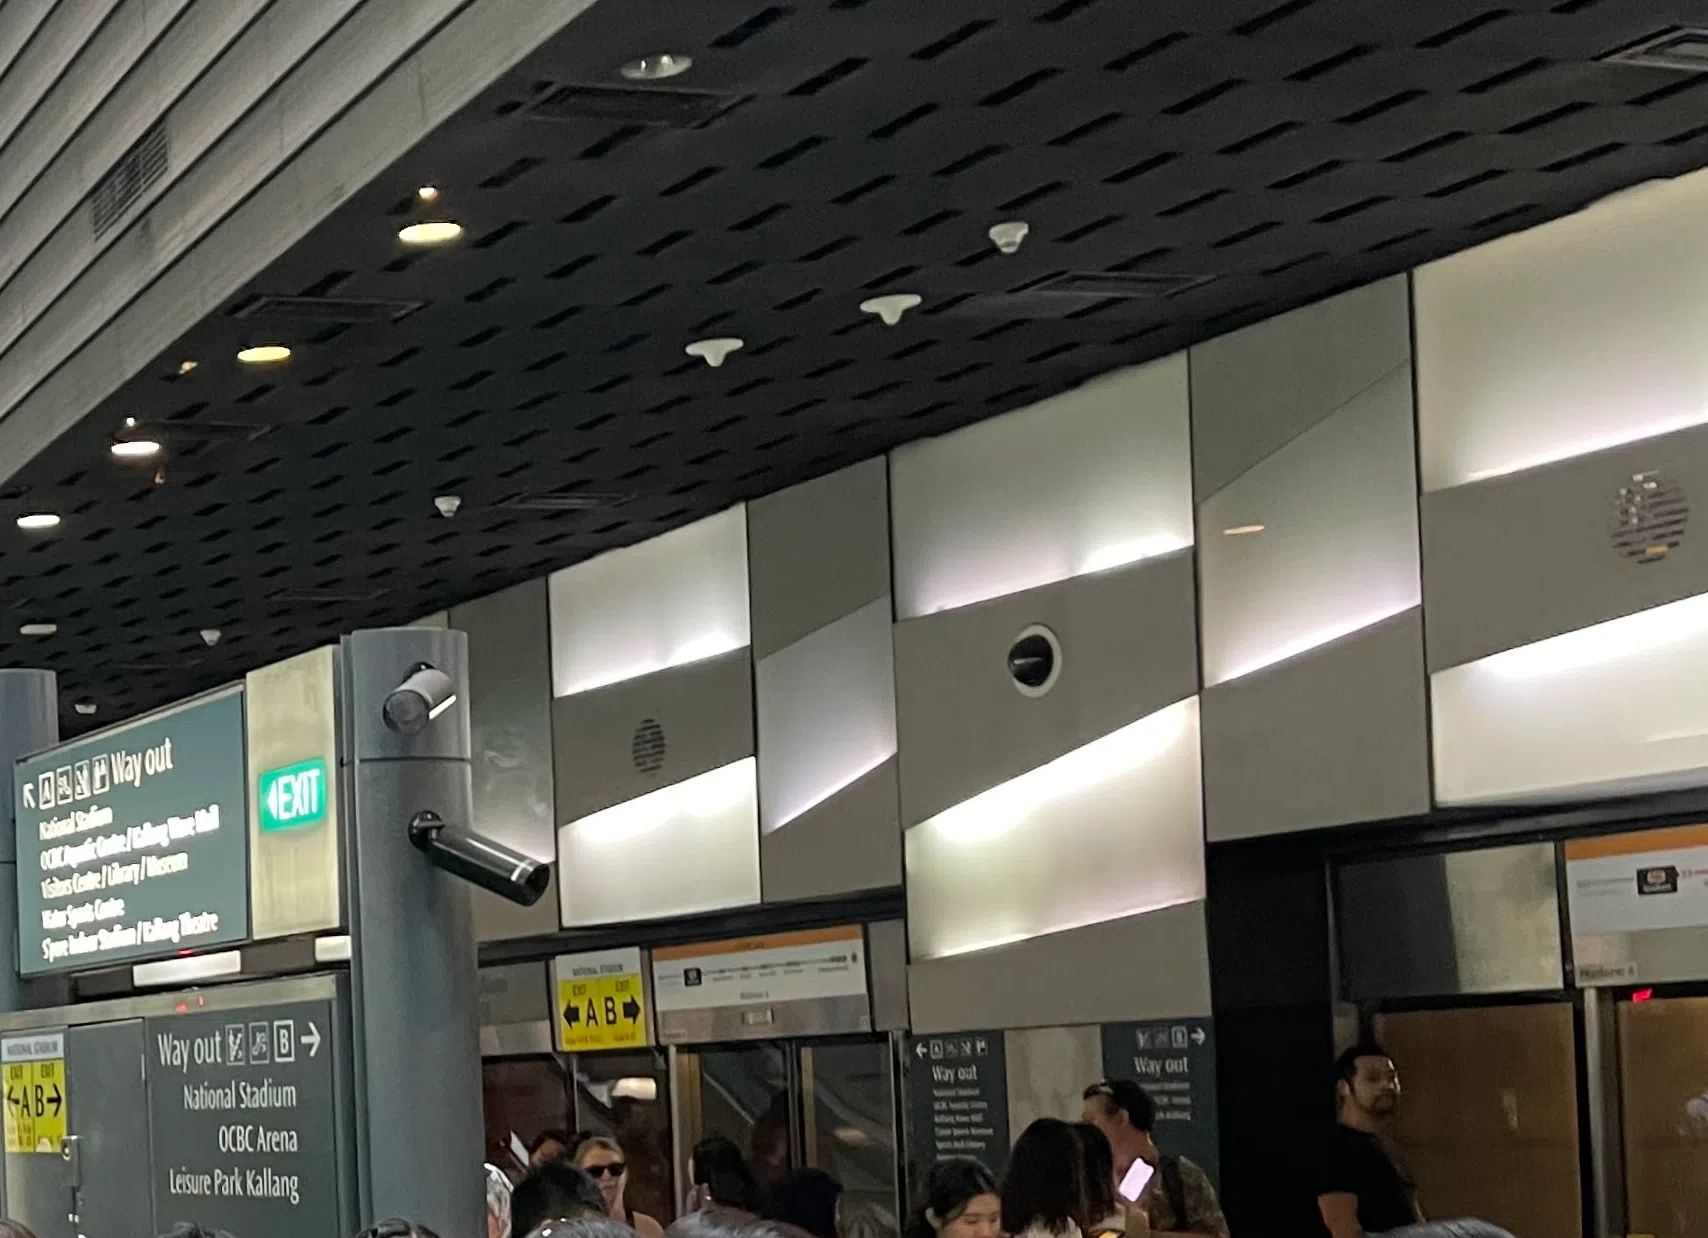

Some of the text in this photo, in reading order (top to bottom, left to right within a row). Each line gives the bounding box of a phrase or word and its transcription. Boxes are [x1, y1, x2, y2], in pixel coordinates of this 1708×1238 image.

[110, 750, 142, 787] Way
[144, 737, 174, 775] out
[278, 769, 320, 820] EXIT
[586, 996, 617, 1028] A B
[157, 1032, 190, 1073] Way
[194, 1030, 222, 1064] out
[1133, 1056, 1188, 1077] Way out
[932, 1064, 977, 1084] Way out
[21, 1084, 44, 1117] A B
[183, 1078, 297, 1110] National Stadium
[218, 1125, 298, 1152] OCBC Arena
[169, 1166, 300, 1205] Leisure Park Kallang
